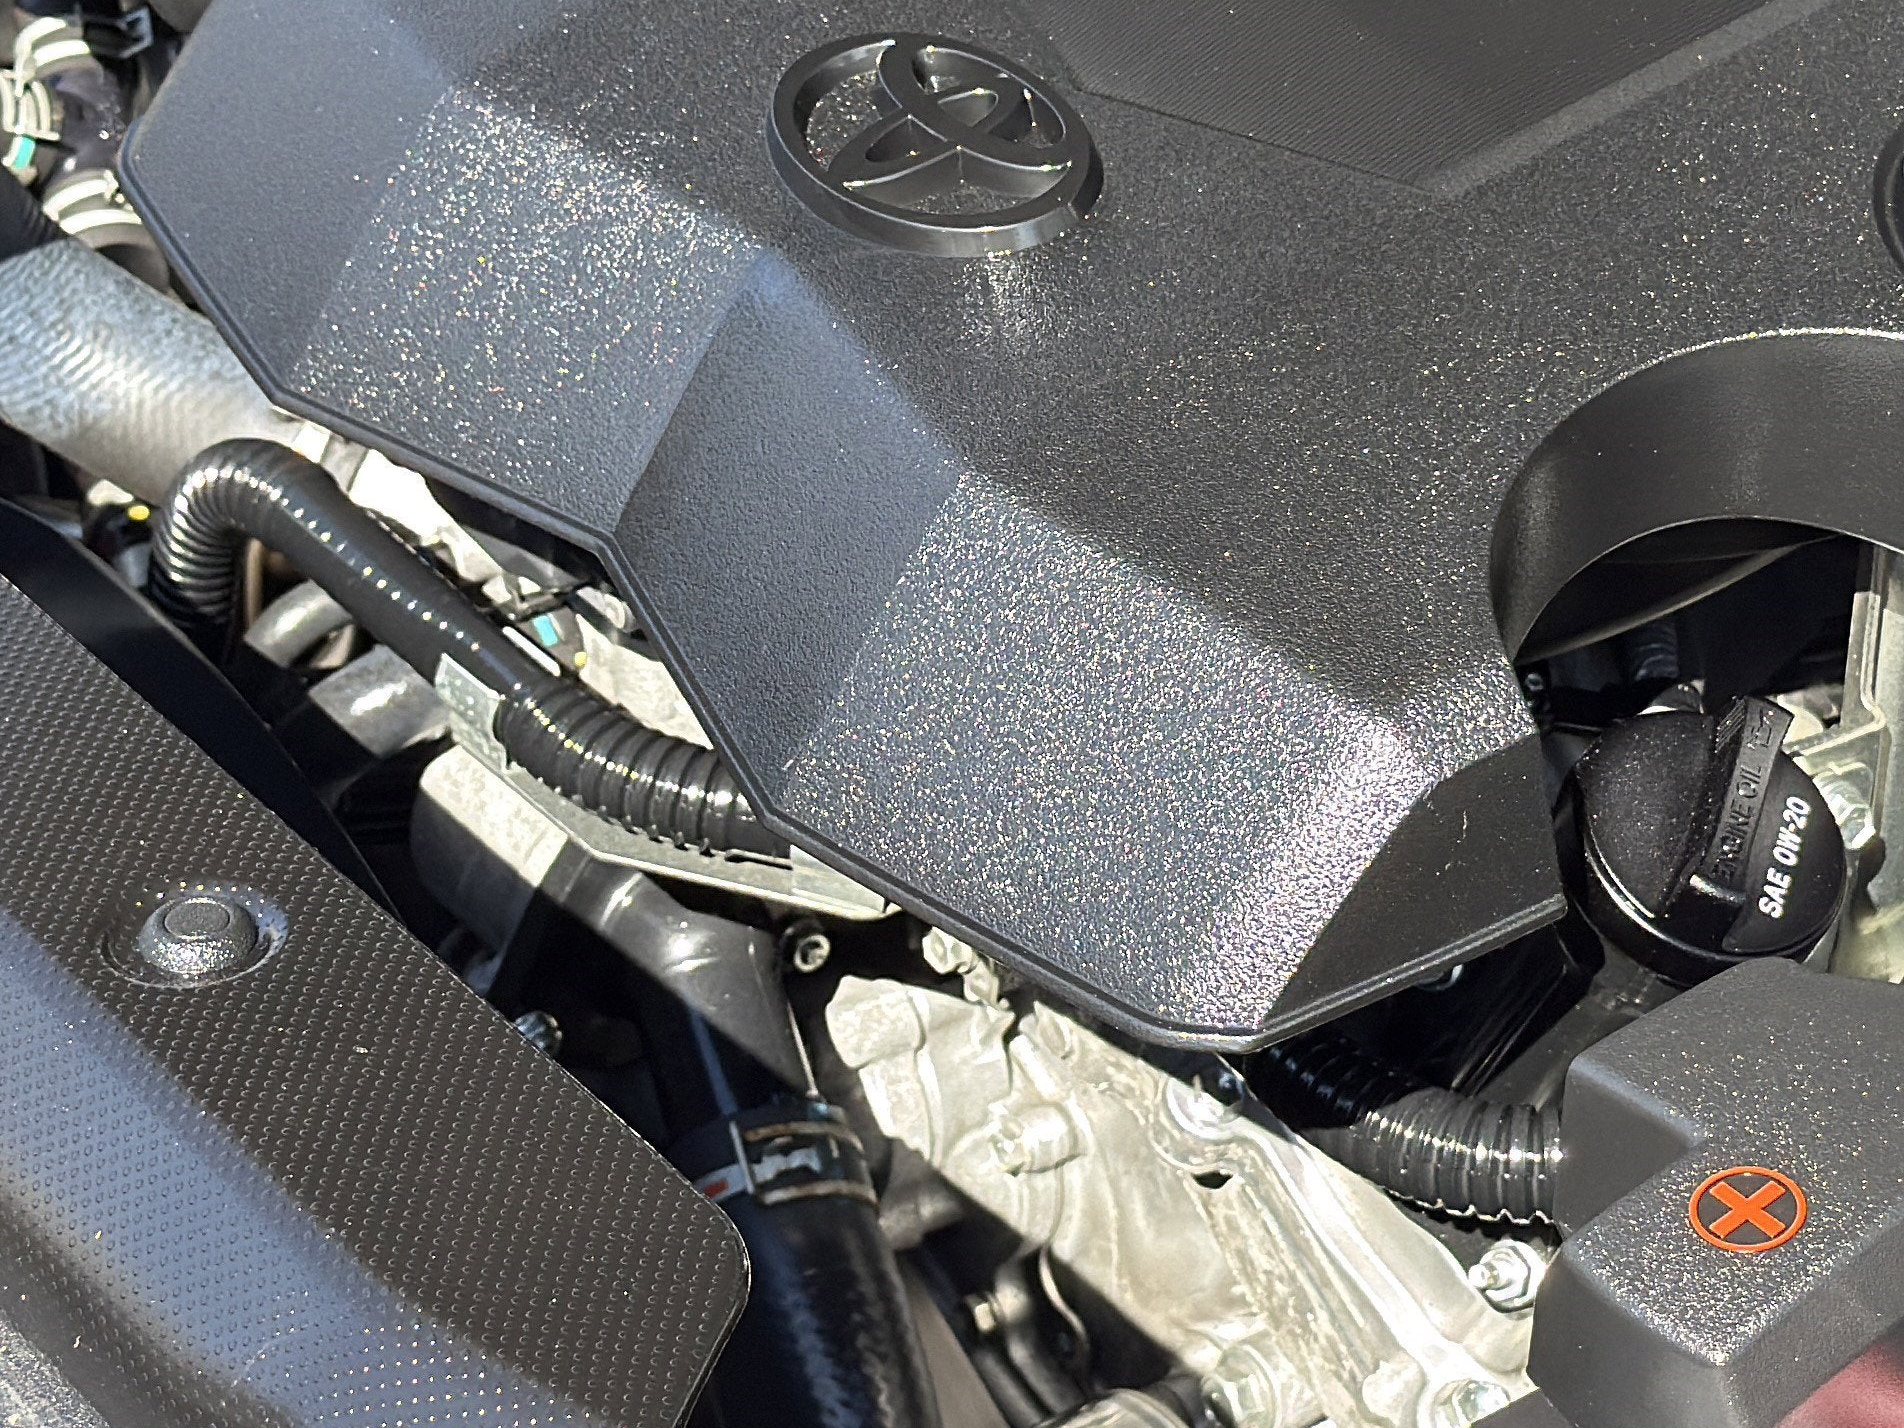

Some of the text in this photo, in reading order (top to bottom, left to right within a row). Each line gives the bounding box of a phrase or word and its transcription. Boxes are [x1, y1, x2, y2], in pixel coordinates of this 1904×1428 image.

[1737, 766, 1763, 799] OIL
[1758, 796, 1811, 919] SAE 0W-20
